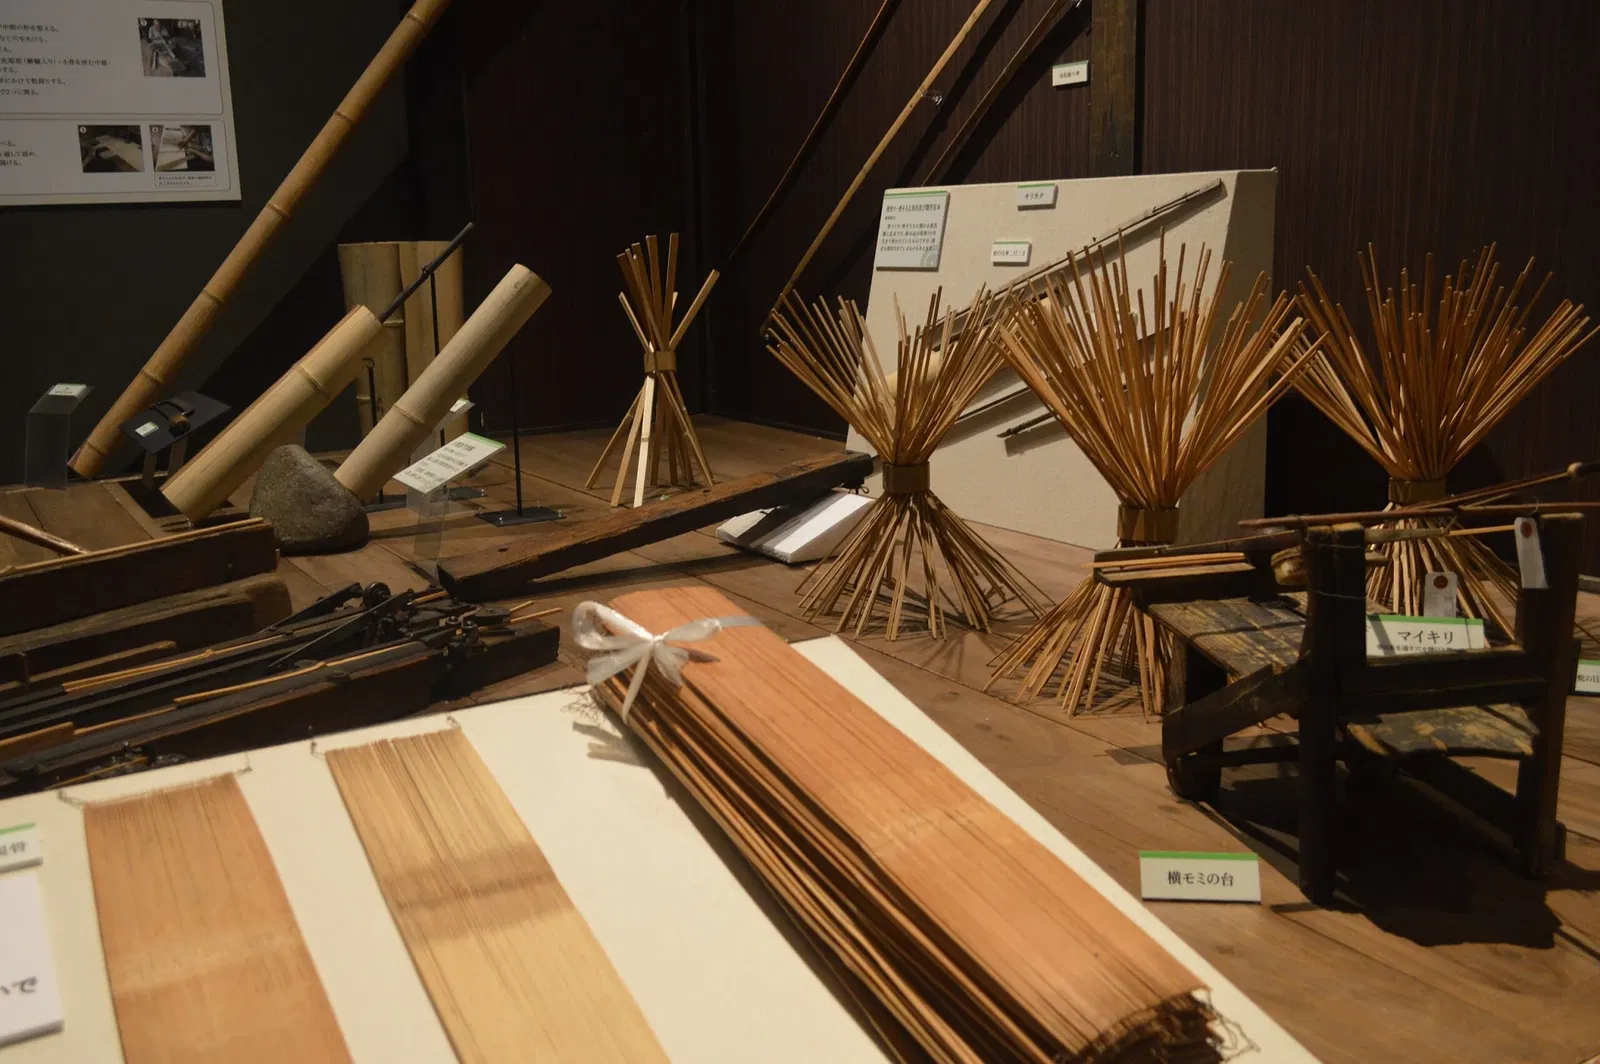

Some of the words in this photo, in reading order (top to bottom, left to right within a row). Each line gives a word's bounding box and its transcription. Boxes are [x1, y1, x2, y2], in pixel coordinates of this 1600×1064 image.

[1397, 630, 1454, 645] マイキリ
[1167, 870, 1234, 887] 横モミの台
